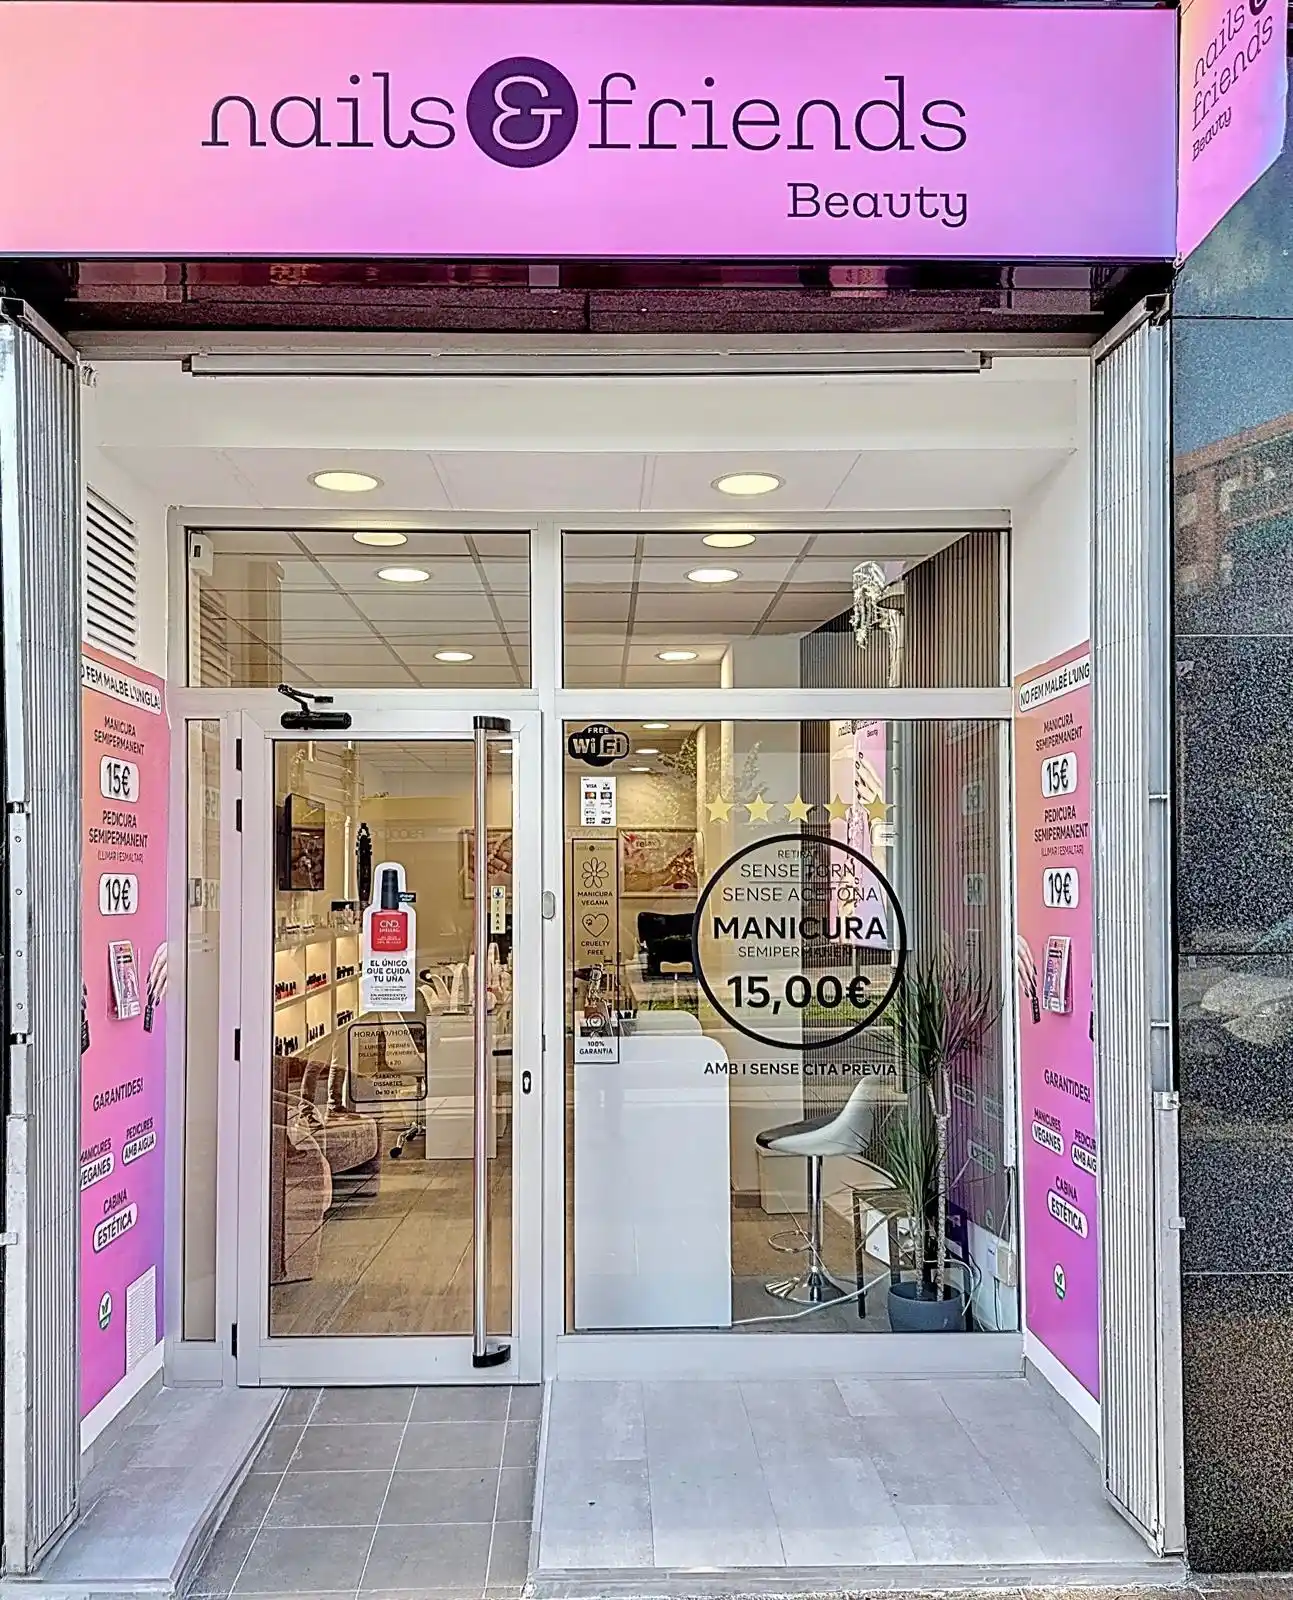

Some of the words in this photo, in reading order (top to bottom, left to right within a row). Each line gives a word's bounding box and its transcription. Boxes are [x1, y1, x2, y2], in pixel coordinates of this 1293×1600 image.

[1193, 4, 1245, 88] nails
[1192, 15, 1273, 131] friends
[201, 71, 456, 149] nails
[588, 71, 967, 152] friends
[1192, 106, 1232, 162] Beauty
[787, 182, 968, 228] Beauty
[86, 665, 103, 686] FEM
[1020, 690, 1030, 706] NO
[1030, 684, 1044, 703] FEM
[104, 715, 136, 737] MANICURA
[1043, 712, 1074, 733] MANICURA
[94, 729, 145, 756] SEMIPERMANENT
[1035, 725, 1083, 751] SEMIPERMANENT
[106, 762, 131, 796] 15€
[1046, 758, 1069, 792] 15€
[102, 810, 137, 829] PEDICURA
[1044, 805, 1077, 823] PEDICURA
[88, 827, 149, 848] SEMIPERMANENT
[1034, 822, 1089, 843] SEMIPERMANENT
[740, 863, 800, 878] SENSE
[804, 863, 857, 878] TORN
[105, 878, 131, 911] 19€
[722, 887, 783, 902] SENSE
[788, 887, 879, 902] ACETONA
[1048, 872, 1072, 904] 19€
[713, 916, 887, 940] MANICURA
[382, 957, 408, 967] ÚNICO
[738, 946, 859, 958] SEMIPERMANEN
[366, 967, 384, 975] QUE
[385, 967, 411, 975] CUIDA
[727, 975, 872, 1015] 15,00€
[703, 1062, 738, 1075] AMB
[750, 1063, 799, 1075] SENSE
[803, 1063, 839, 1075] CITA
[92, 1077, 144, 1112] GARANTIDES!
[1044, 1069, 1091, 1103] GARANTIDES!
[126, 1117, 154, 1140] PEDICURES
[1033, 1107, 1061, 1131] MANICURES
[124, 1143, 138, 1160] AMB
[137, 1133, 154, 1152] AIGUA
[1033, 1124, 1061, 1152] VEGANES
[1073, 1147, 1086, 1166] AMB
[103, 1188, 128, 1214] CABINA
[1055, 1175, 1078, 1202] CABINA
